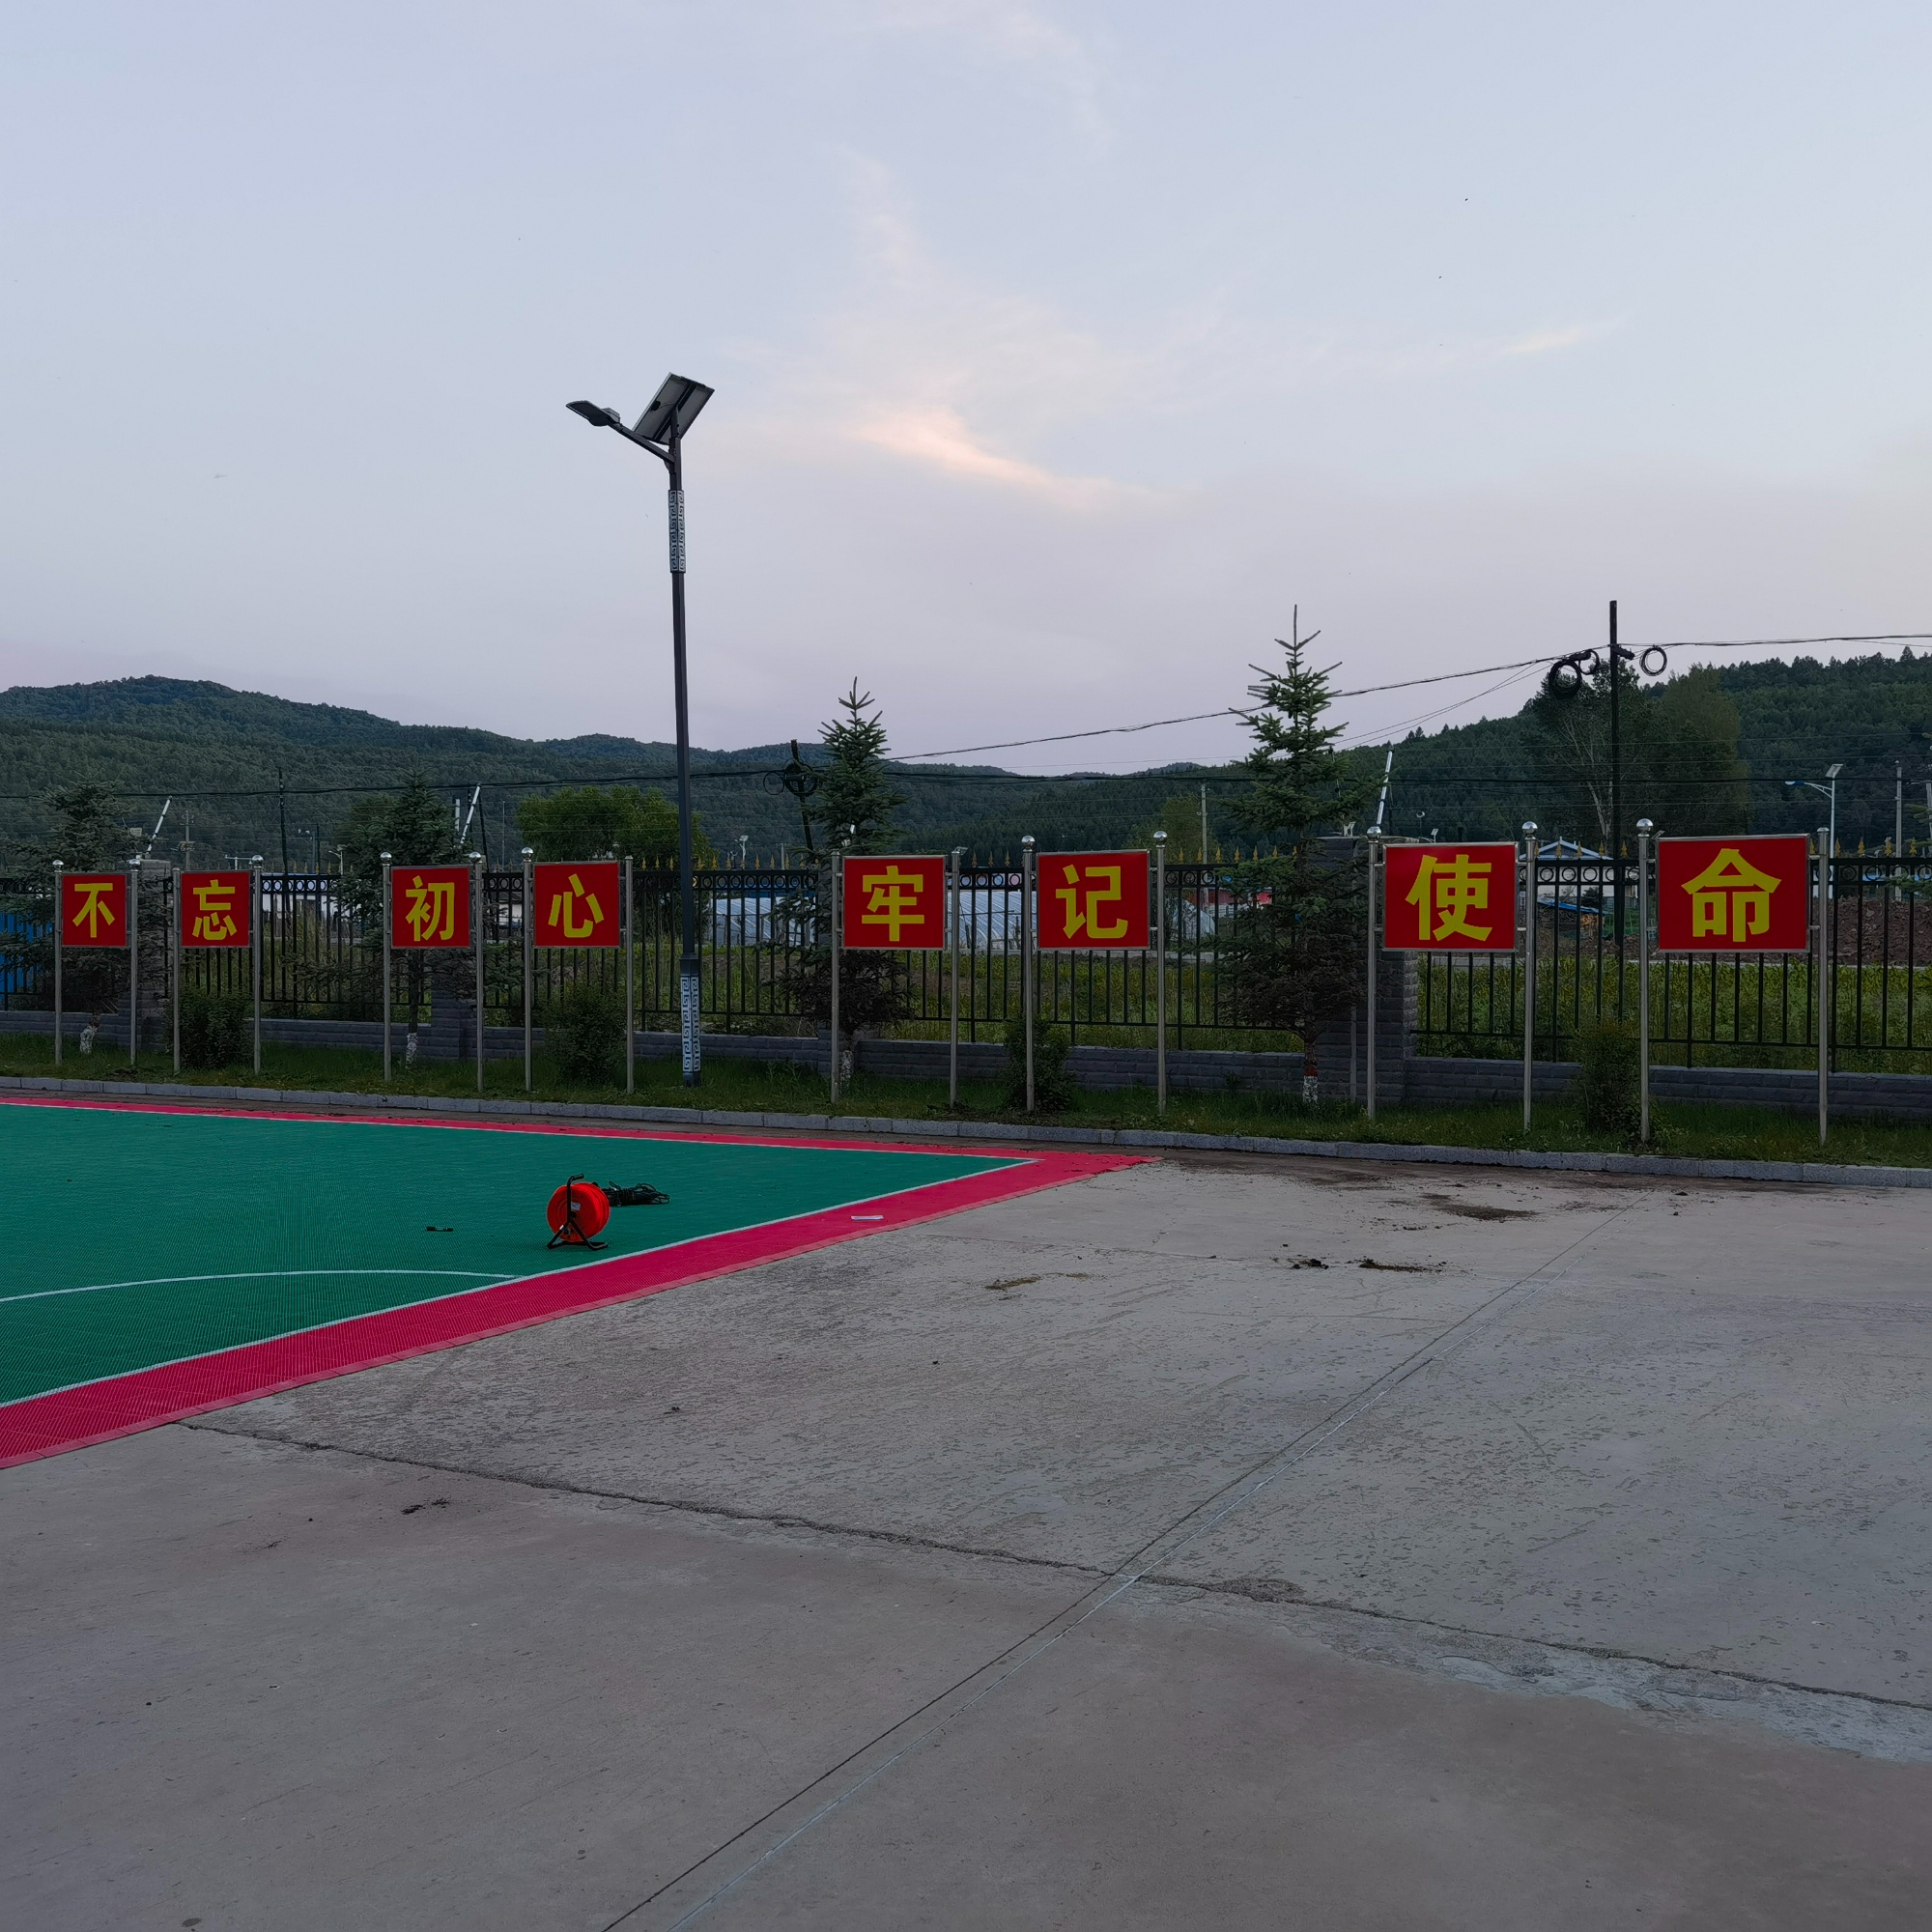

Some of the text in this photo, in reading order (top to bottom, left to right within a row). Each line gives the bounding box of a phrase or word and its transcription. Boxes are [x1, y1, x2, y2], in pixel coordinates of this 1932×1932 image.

[72, 883, 114, 937] 不
[192, 880, 237, 940] 忘
[406, 876, 454, 941] 初
[549, 874, 604, 937] 心
[862, 866, 924, 941] 牢
[1056, 865, 1127, 938] 记
[1406, 855, 1492, 941] 使
[1682, 849, 1781, 942] 命
